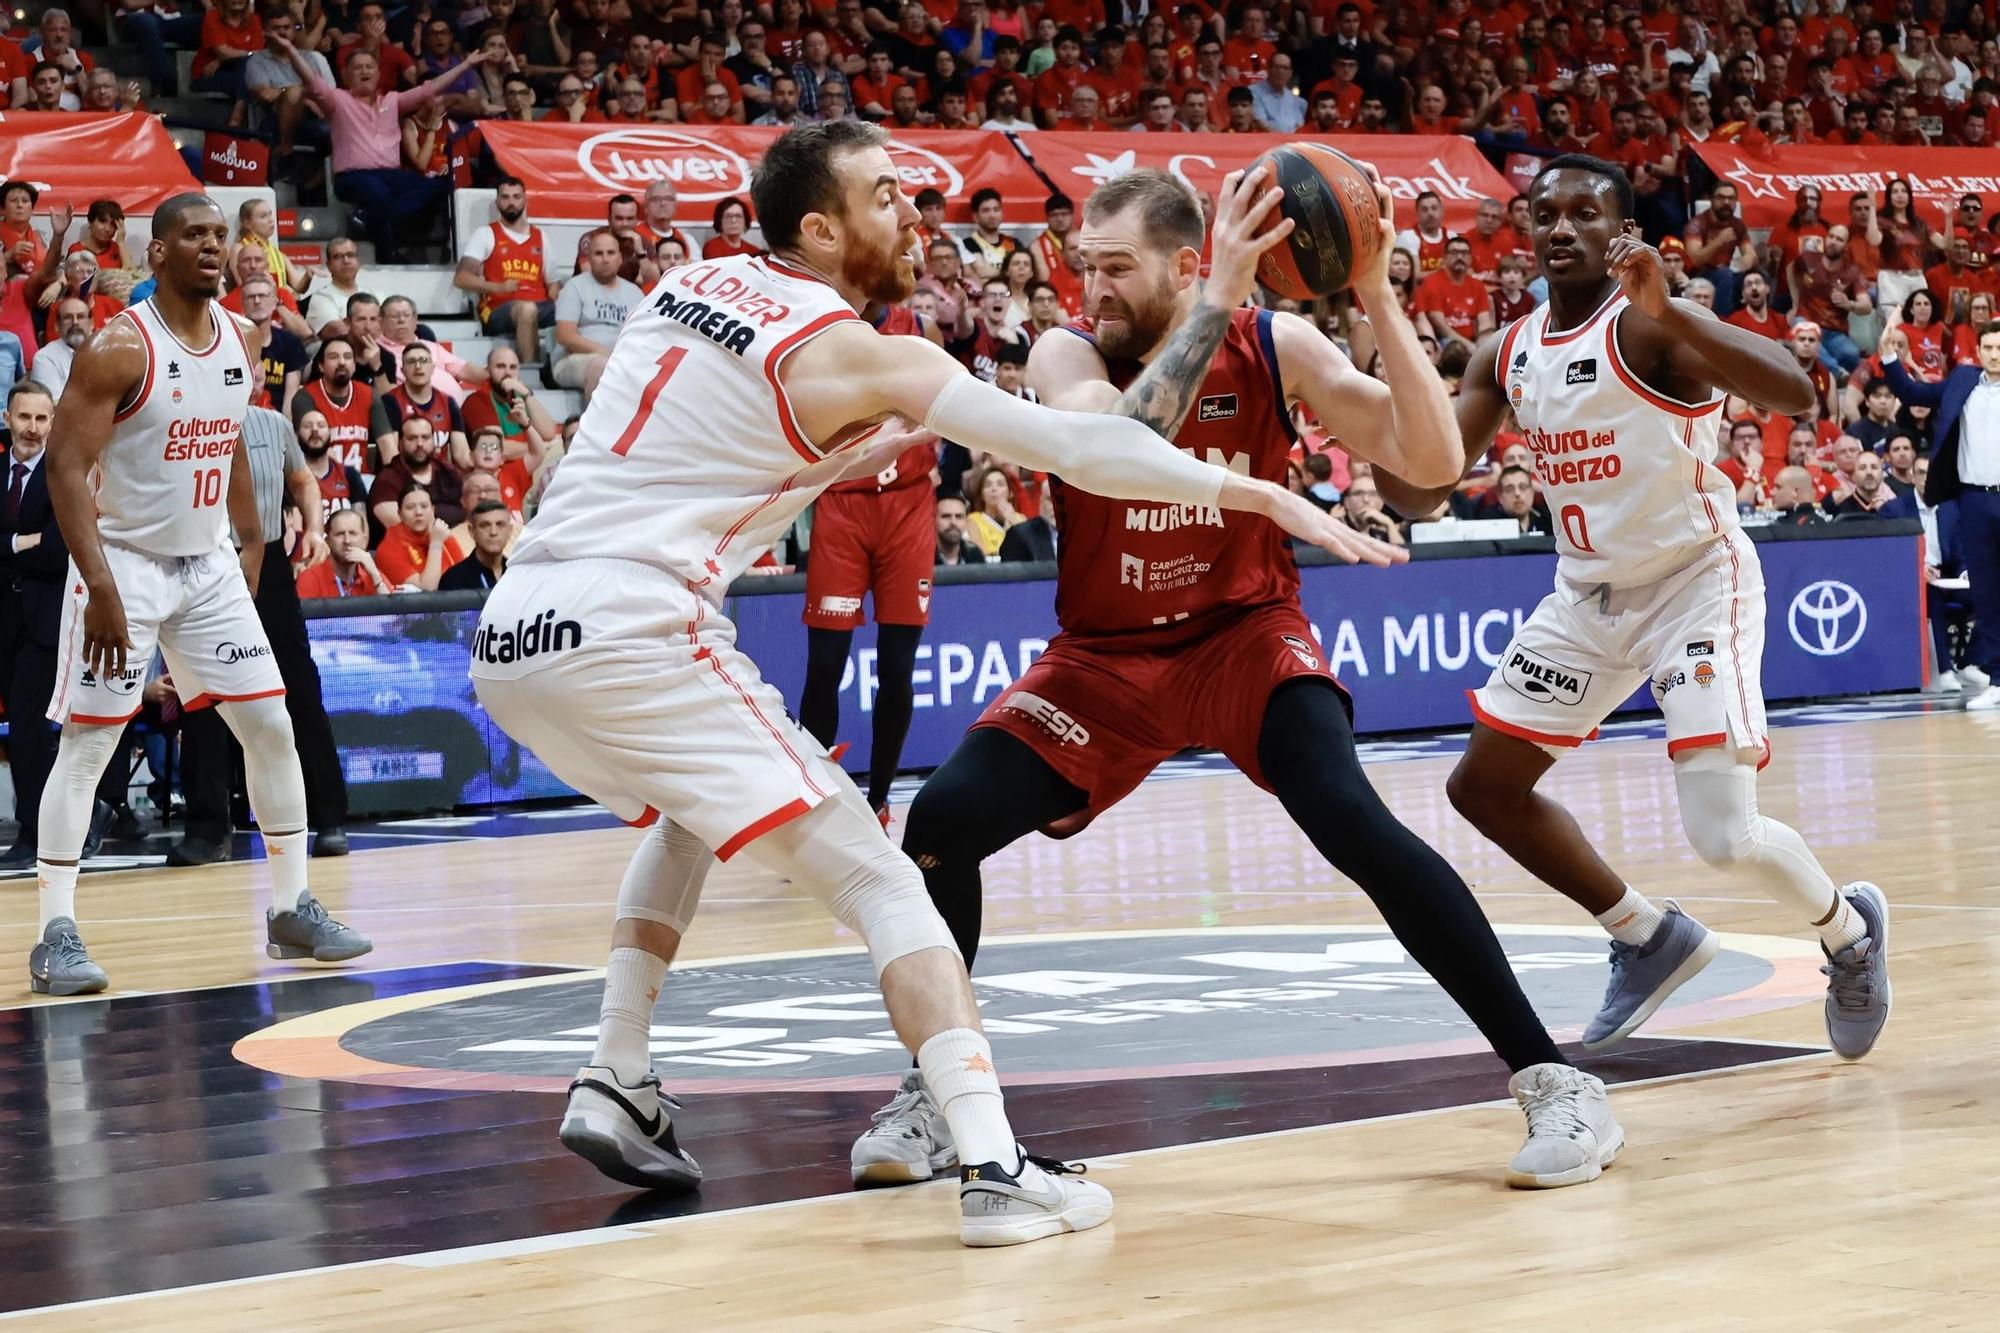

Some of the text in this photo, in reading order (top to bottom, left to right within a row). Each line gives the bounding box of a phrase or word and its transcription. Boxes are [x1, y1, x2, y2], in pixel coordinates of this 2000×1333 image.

[609, 152, 729, 182] Juver
[502, 258, 540, 275] UCAM
[679, 265, 790, 328] CLAVER
[649, 291, 756, 357] PAMESA
[610, 346, 689, 457] 1
[1202, 403, 1218, 413] liga
[1202, 407, 1235, 418] endesa
[168, 417, 231, 440] Cultura
[1592, 430, 1615, 448] del
[192, 468, 222, 509] 10
[1125, 503, 1225, 532] MURCIA
[1561, 504, 1597, 553] 0
[1150, 572, 1162, 581] DE
[1162, 571, 1173, 580] LA
[1688, 646, 1709, 656] acb
[1509, 652, 1579, 694] PULEVA
[1030, 696, 1090, 746] ESP
